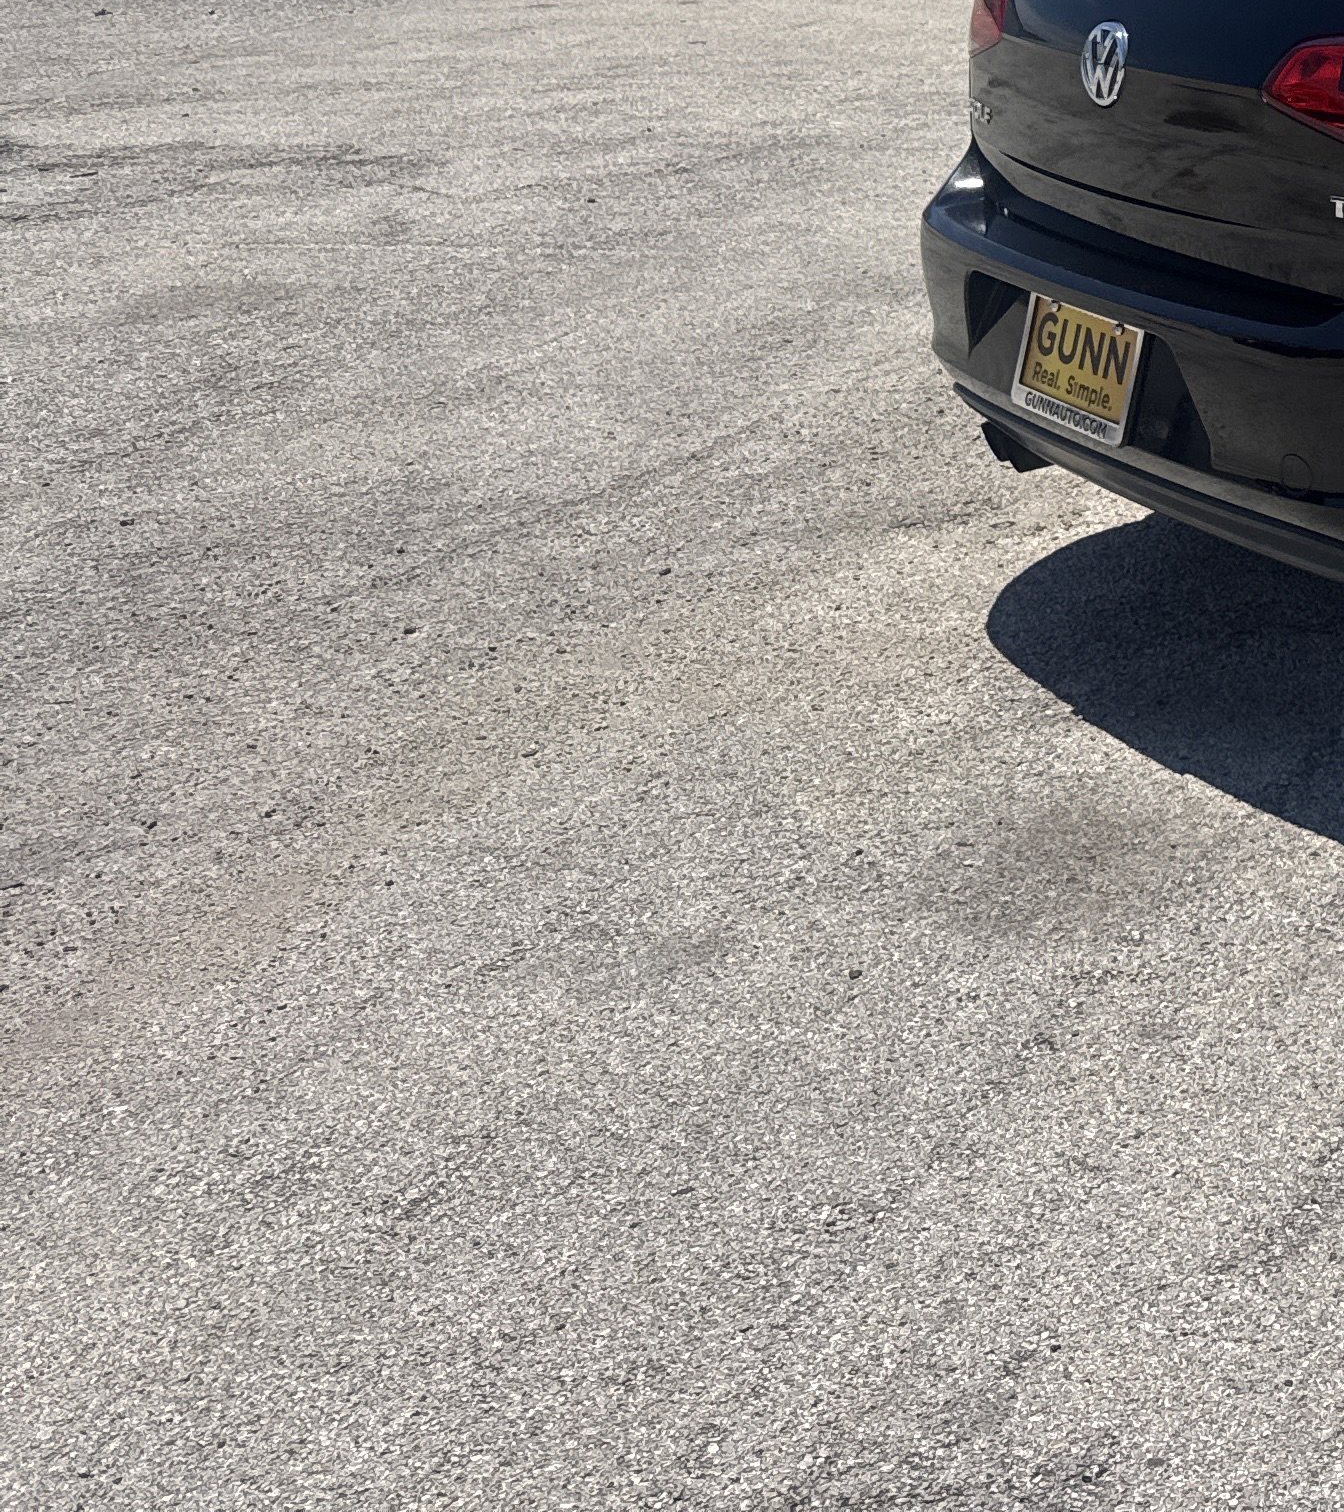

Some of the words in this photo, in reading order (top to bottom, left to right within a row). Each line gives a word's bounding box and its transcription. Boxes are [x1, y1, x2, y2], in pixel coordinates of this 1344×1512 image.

[1037, 311, 1131, 386] GUNN
[1032, 361, 1061, 390] Real.
[1066, 375, 1112, 412] Simple.
[1024, 391, 1108, 439] GUNNAUTO.COM
